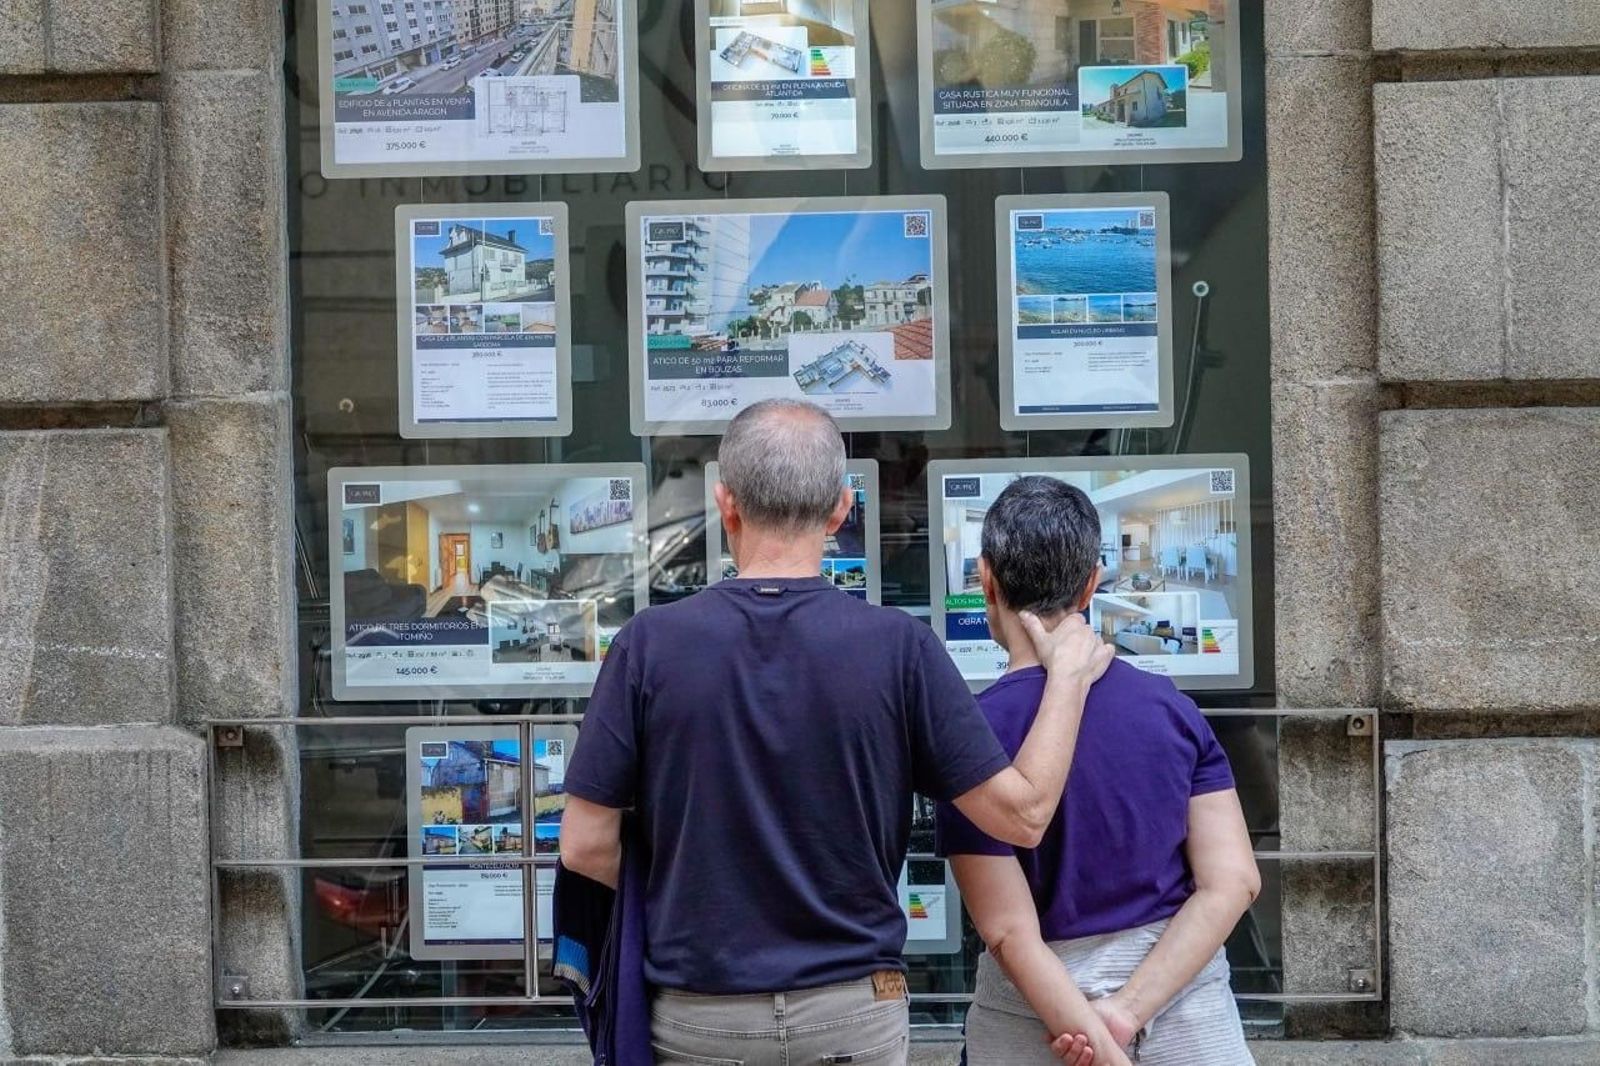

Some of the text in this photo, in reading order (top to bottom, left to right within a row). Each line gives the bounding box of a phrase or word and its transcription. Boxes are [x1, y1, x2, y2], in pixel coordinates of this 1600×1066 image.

[813, 81, 846, 89] AVENIDA
[939, 91, 962, 100] CASA
[1000, 89, 1021, 98] MUY
[1022, 88, 1073, 97] FUNCIONAL
[339, 99, 373, 109] EDIFICIO
[375, 99, 386, 107] DE
[393, 98, 431, 107] PLANTAS
[431, 97, 443, 106] EN
[444, 96, 471, 106] VENTA
[943, 99, 1069, 109] SITUADA EN ZONA TRANQUILA
[363, 109, 376, 118] EN
[376, 108, 412, 117] AVENIDA
[985, 133, 1028, 142] 440.000 €
[385, 141, 427, 151] 375.000 €
[678, 356, 690, 364] DE
[691, 357, 701, 366] 50
[716, 355, 738, 363] PARA
[739, 354, 784, 363] REFORMAR
[695, 365, 743, 375] EN BOUZAS
[700, 398, 738, 408] 83.000 €
[945, 597, 986, 606] ALTOS HON
[388, 622, 410, 631] TRES
[411, 621, 470, 631] DORMITORIOS
[958, 617, 982, 625] OBRA
[396, 665, 438, 676] 145.000 €
